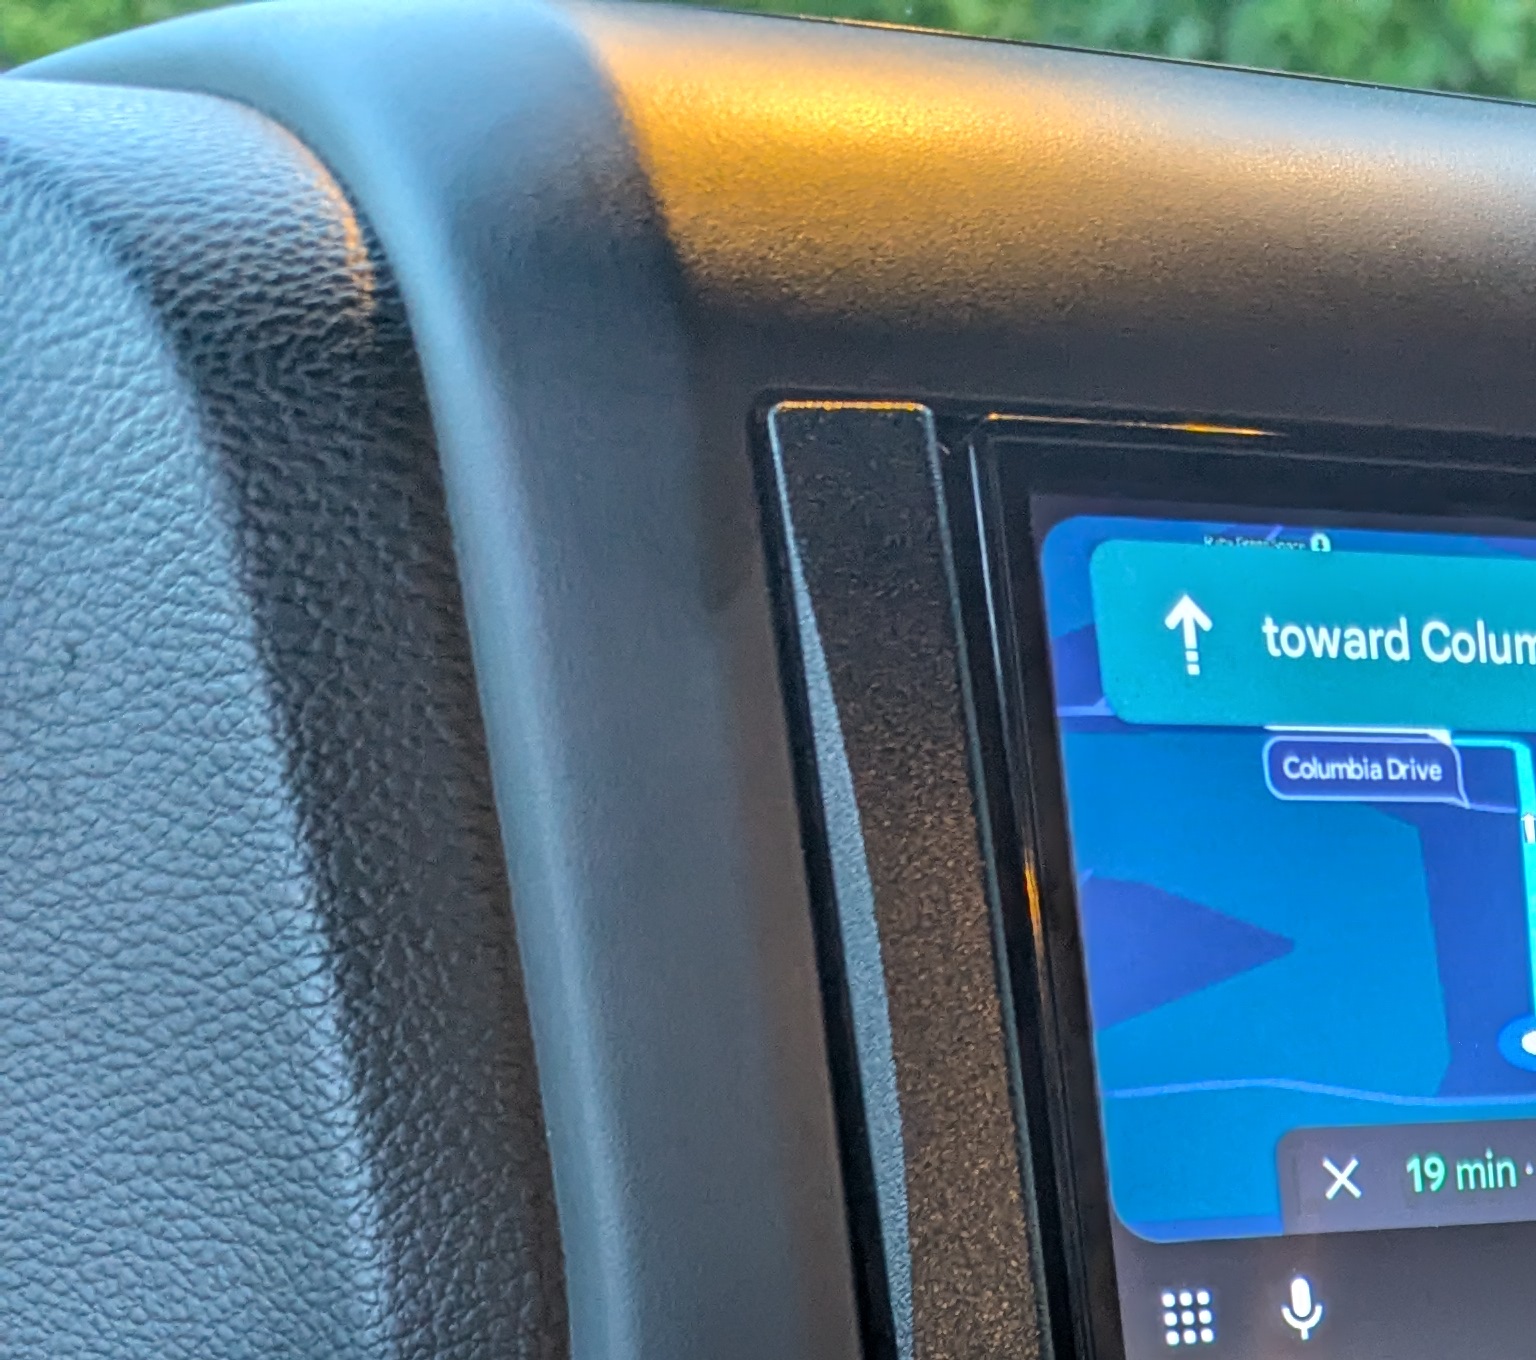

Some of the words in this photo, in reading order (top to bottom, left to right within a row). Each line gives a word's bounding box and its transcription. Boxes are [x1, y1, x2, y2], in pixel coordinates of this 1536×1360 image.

[1262, 617, 1411, 662] toward
[1282, 757, 1382, 782] Columbia
[1388, 760, 1443, 784] Drive
[1407, 1153, 1447, 1193] 19
[1456, 1149, 1517, 1190] min
